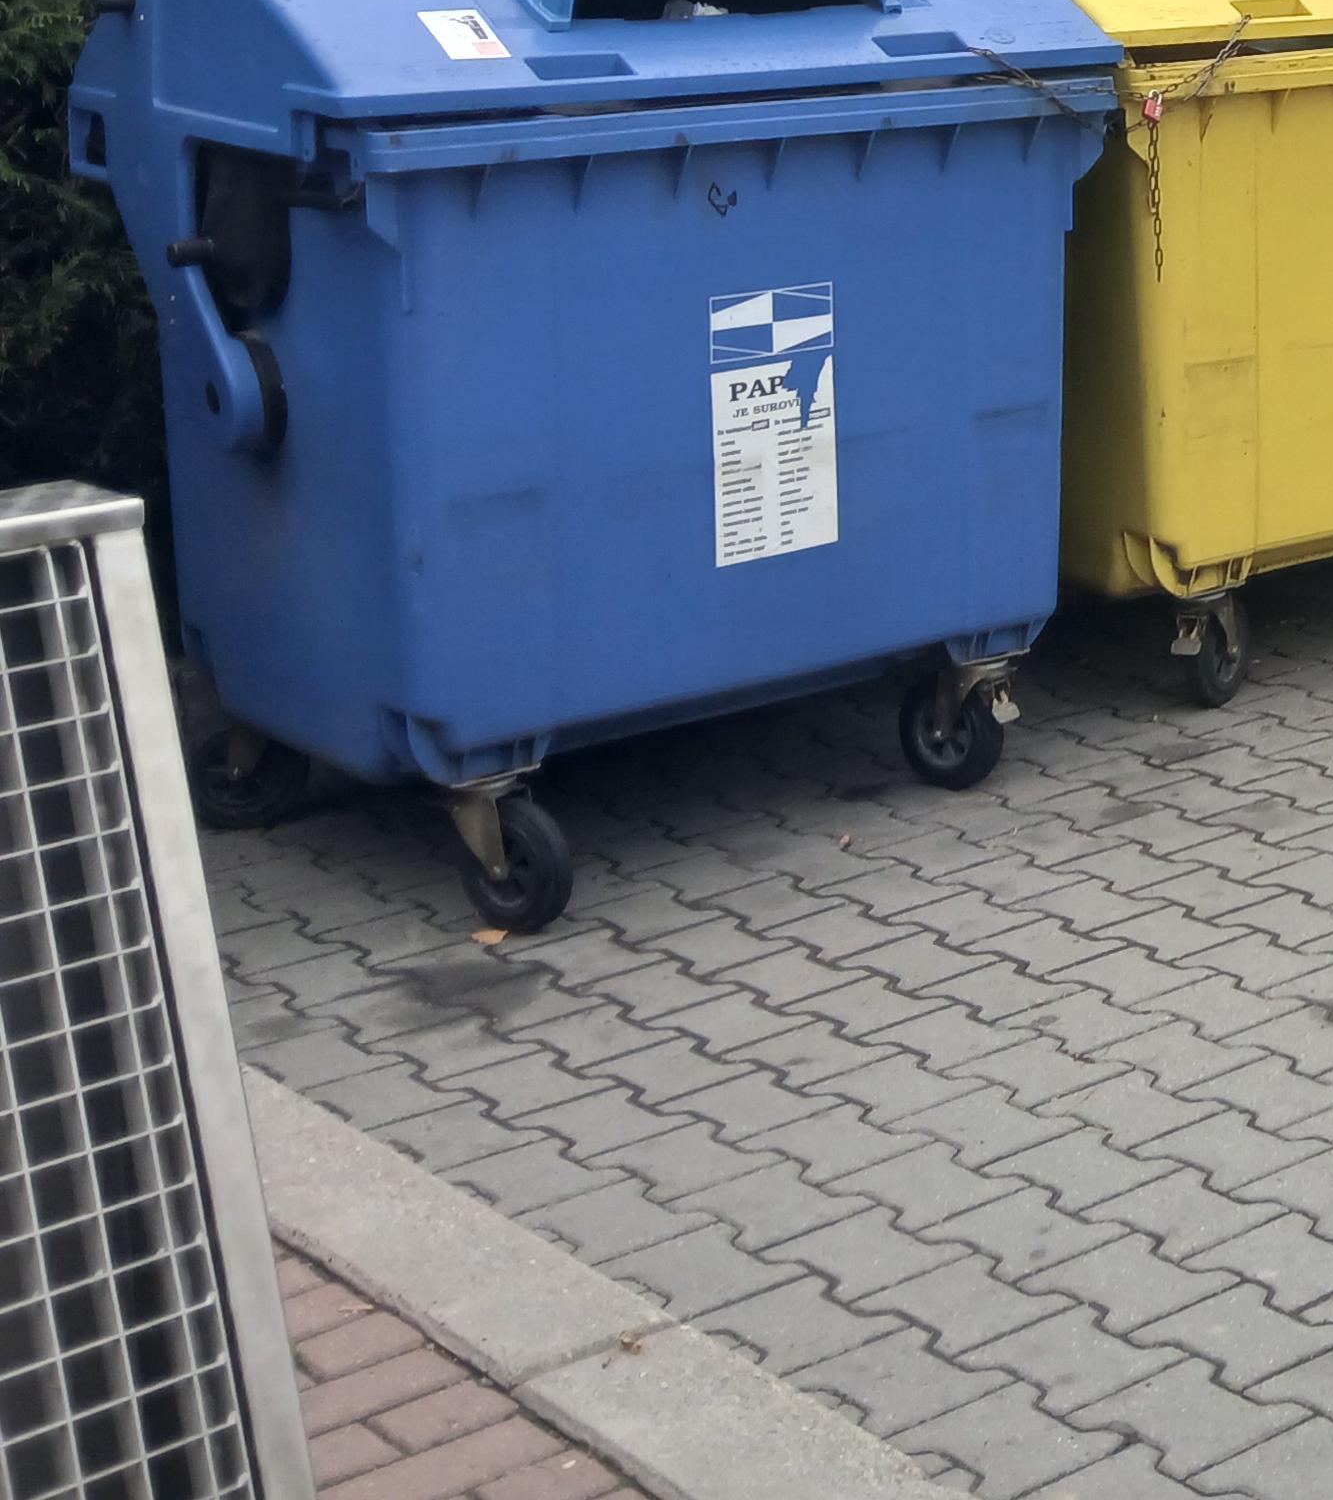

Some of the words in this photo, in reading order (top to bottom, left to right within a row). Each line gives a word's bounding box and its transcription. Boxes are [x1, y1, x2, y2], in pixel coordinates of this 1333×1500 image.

[729, 375, 795, 402] PAP
[732, 407, 750, 419] JE
[753, 398, 801, 415] SUROVI
